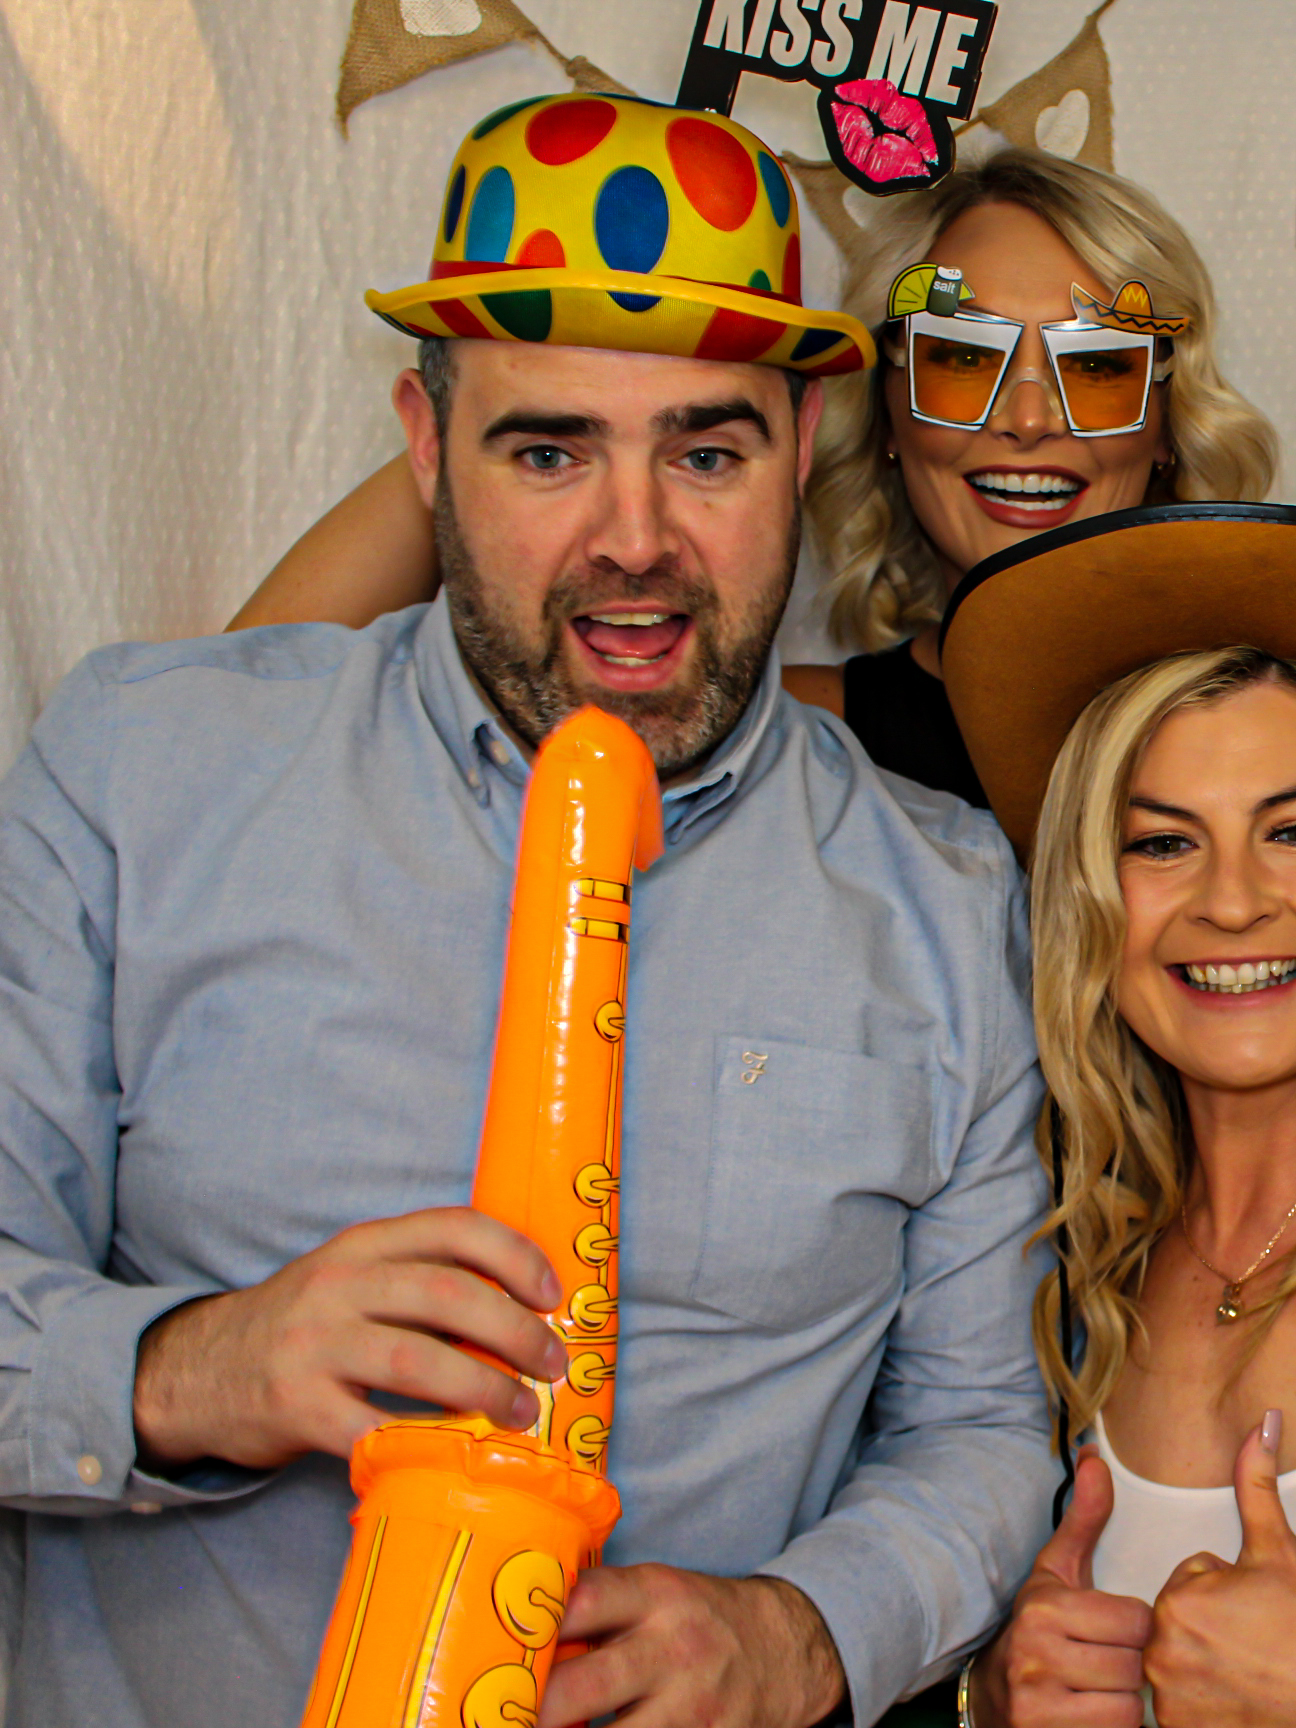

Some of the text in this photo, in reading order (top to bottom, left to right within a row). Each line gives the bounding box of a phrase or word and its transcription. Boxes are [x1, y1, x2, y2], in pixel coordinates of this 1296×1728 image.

[703, 0, 979, 106] KISS ME
[933, 281, 956, 295] salt
